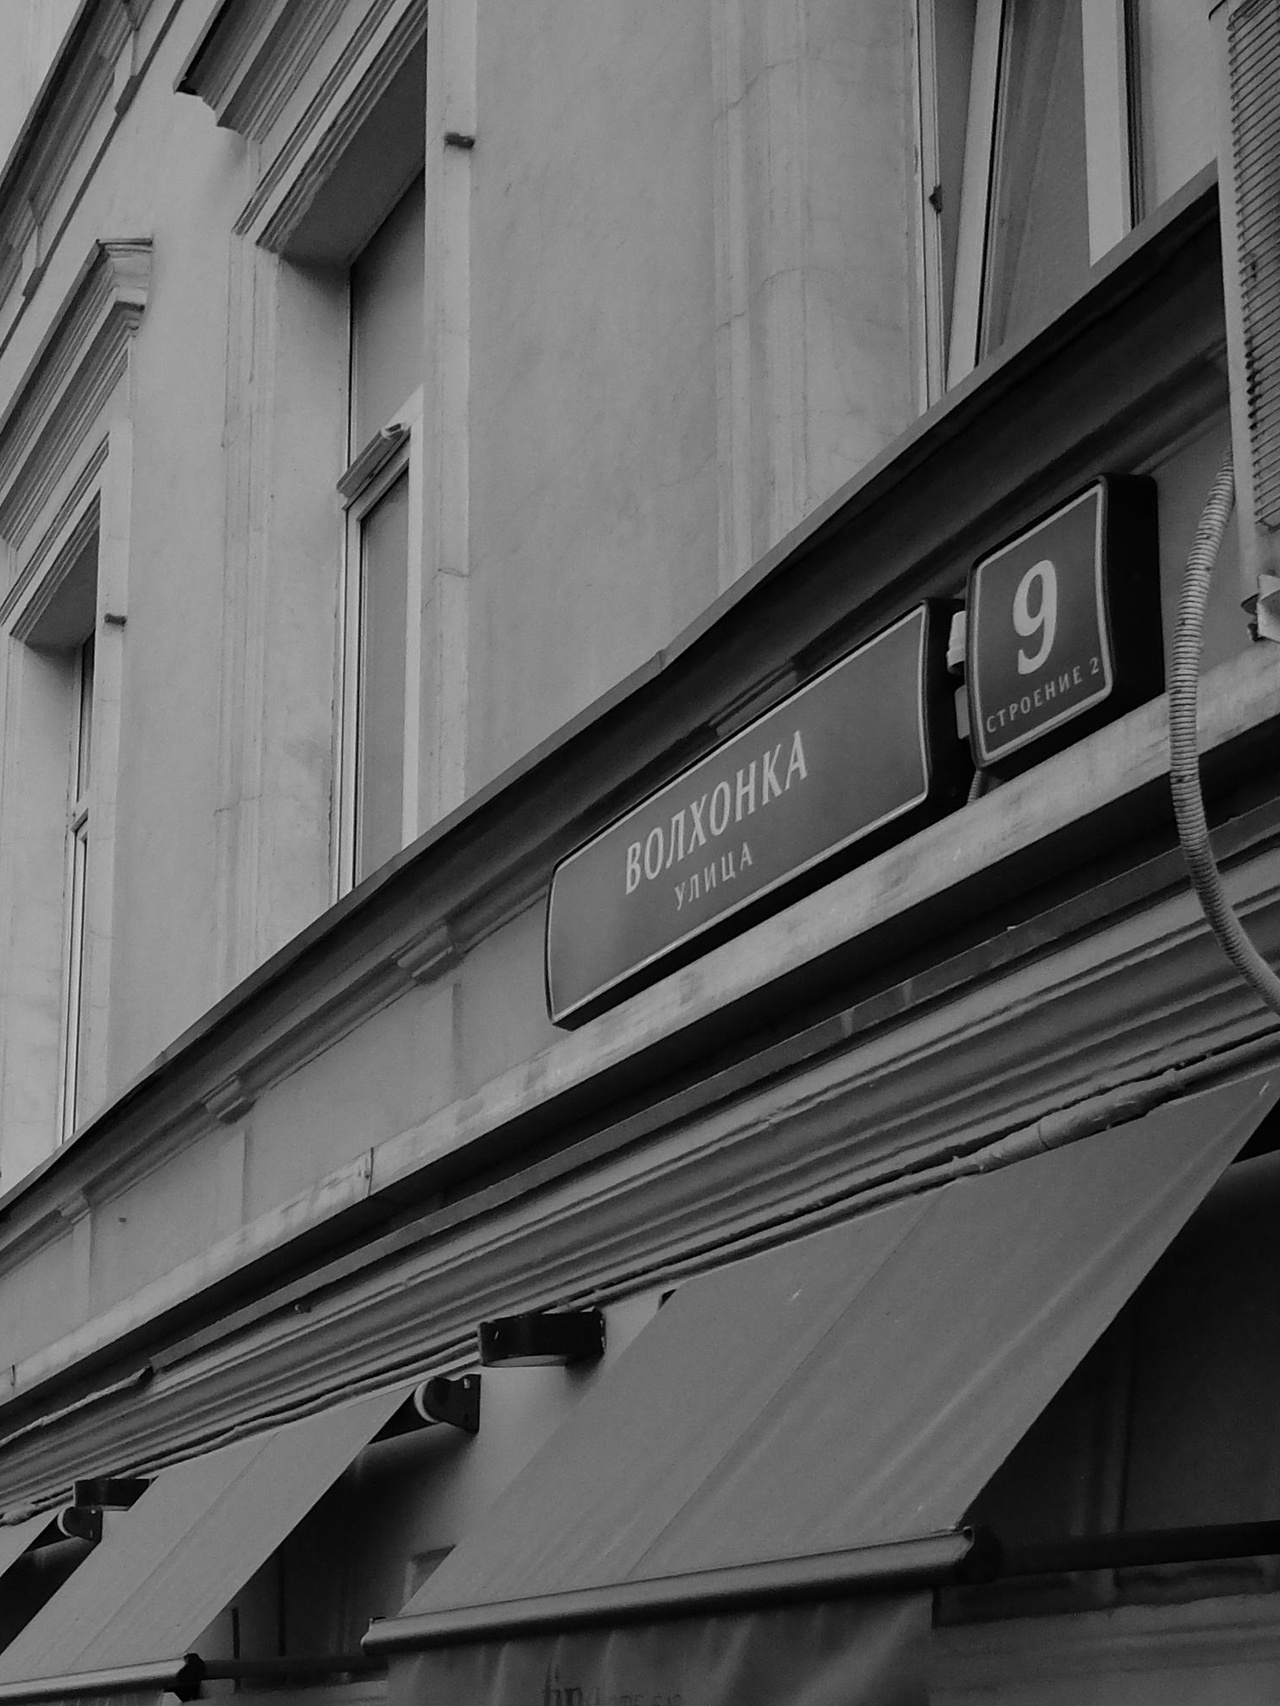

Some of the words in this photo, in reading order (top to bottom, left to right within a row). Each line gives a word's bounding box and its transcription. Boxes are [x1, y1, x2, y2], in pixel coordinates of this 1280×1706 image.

[1012, 559, 1058, 675] 9
[986, 665, 1082, 733] СТРОЕНИЕ
[1088, 656, 1100, 676] 2
[624, 730, 809, 896] ВОЛХОНКА
[673, 840, 754, 912] УЛИЦА
